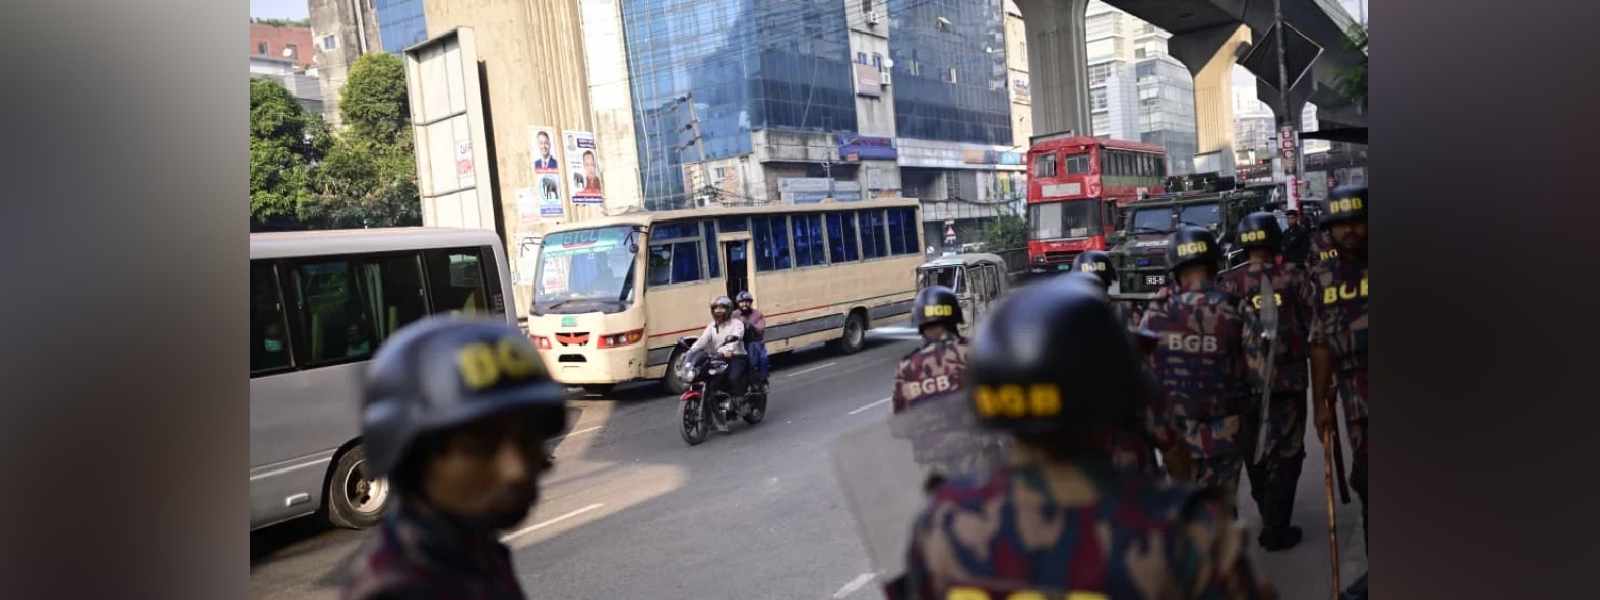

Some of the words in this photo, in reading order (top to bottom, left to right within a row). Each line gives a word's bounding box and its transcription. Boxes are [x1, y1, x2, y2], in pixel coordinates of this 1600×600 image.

[1241, 231, 1266, 242] BGB
[1177, 241, 1207, 257] BGB
[924, 304, 952, 317] BGB
[1168, 333, 1217, 352] BGB
[909, 375, 950, 398] BGB
[976, 384, 1062, 417] BGB
